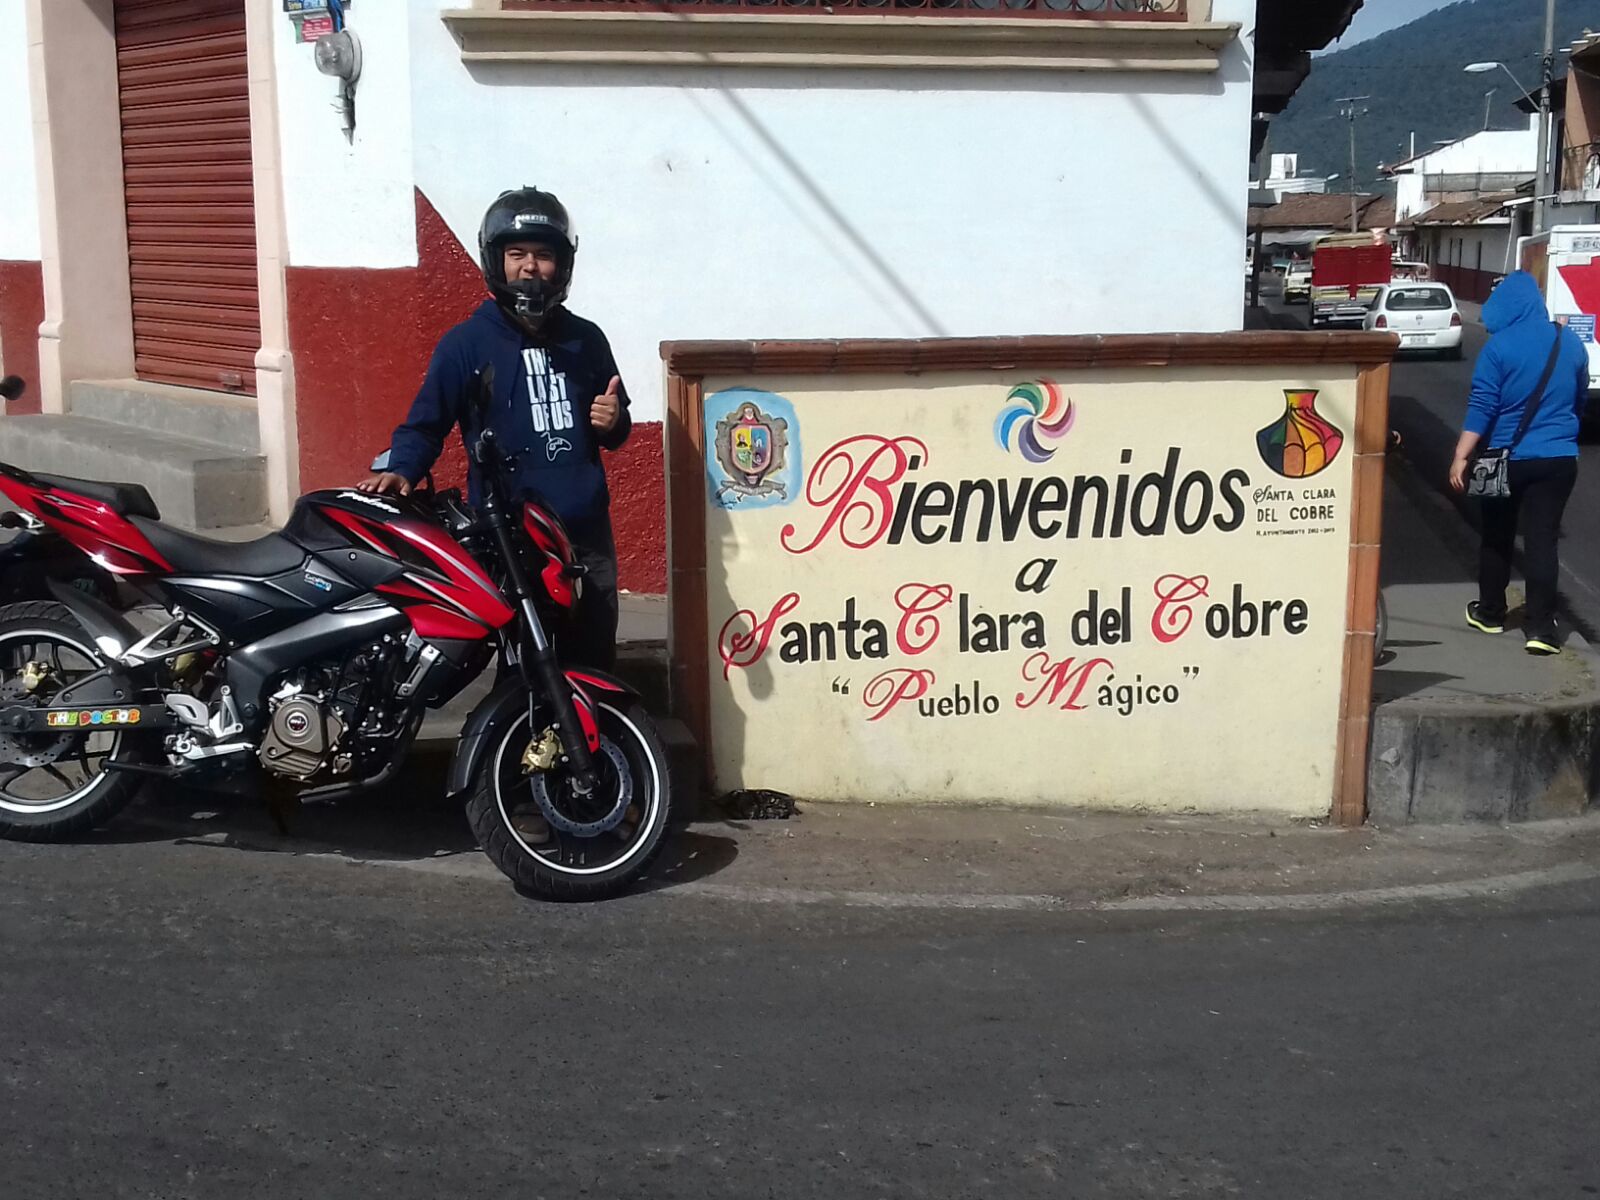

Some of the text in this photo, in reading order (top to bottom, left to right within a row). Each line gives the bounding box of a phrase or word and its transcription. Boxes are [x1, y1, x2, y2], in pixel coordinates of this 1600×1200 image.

[550, 400, 574, 430] US
[781, 434, 1250, 554] Bienvenidos
[1253, 485, 1336, 505] SANTA CLARA
[1257, 504, 1334, 522] DEL COBRE
[1015, 557, 1059, 594] a
[718, 574, 1308, 681] Santa Clara del Cobre
[47, 708, 140, 726] THE DOCTOR
